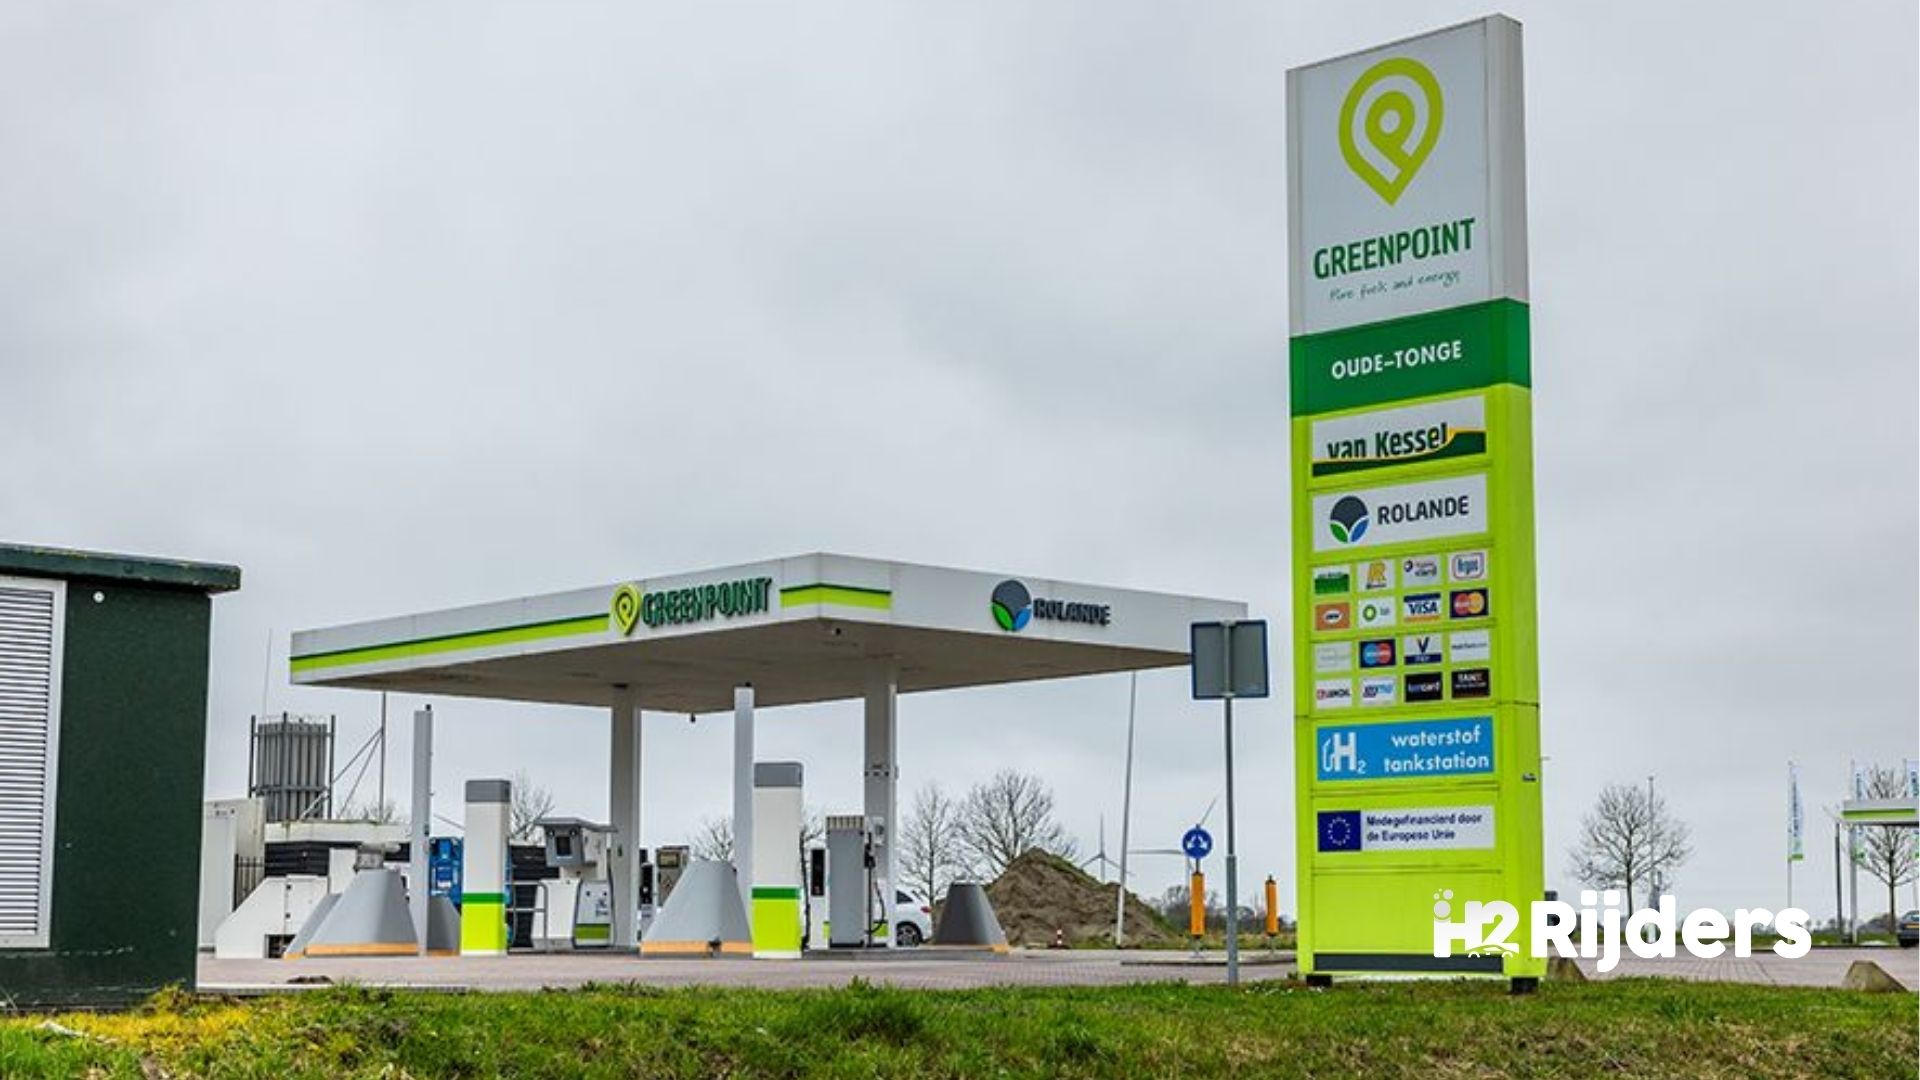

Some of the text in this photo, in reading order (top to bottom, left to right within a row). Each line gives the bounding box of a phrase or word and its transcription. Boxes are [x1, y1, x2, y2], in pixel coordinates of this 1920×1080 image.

[1313, 217, 1476, 280] GREENPOINT
[1331, 340, 1463, 380] OUDE-TONGE
[1327, 422, 1448, 459] van Kessel
[1377, 494, 1470, 526] ROLANDE
[642, 577, 772, 629] GREENPOINT
[1408, 602, 1438, 616] VISA
[1391, 724, 1482, 748] waterstof
[1383, 751, 1490, 773] tankstation
[1458, 812, 1483, 824] door
